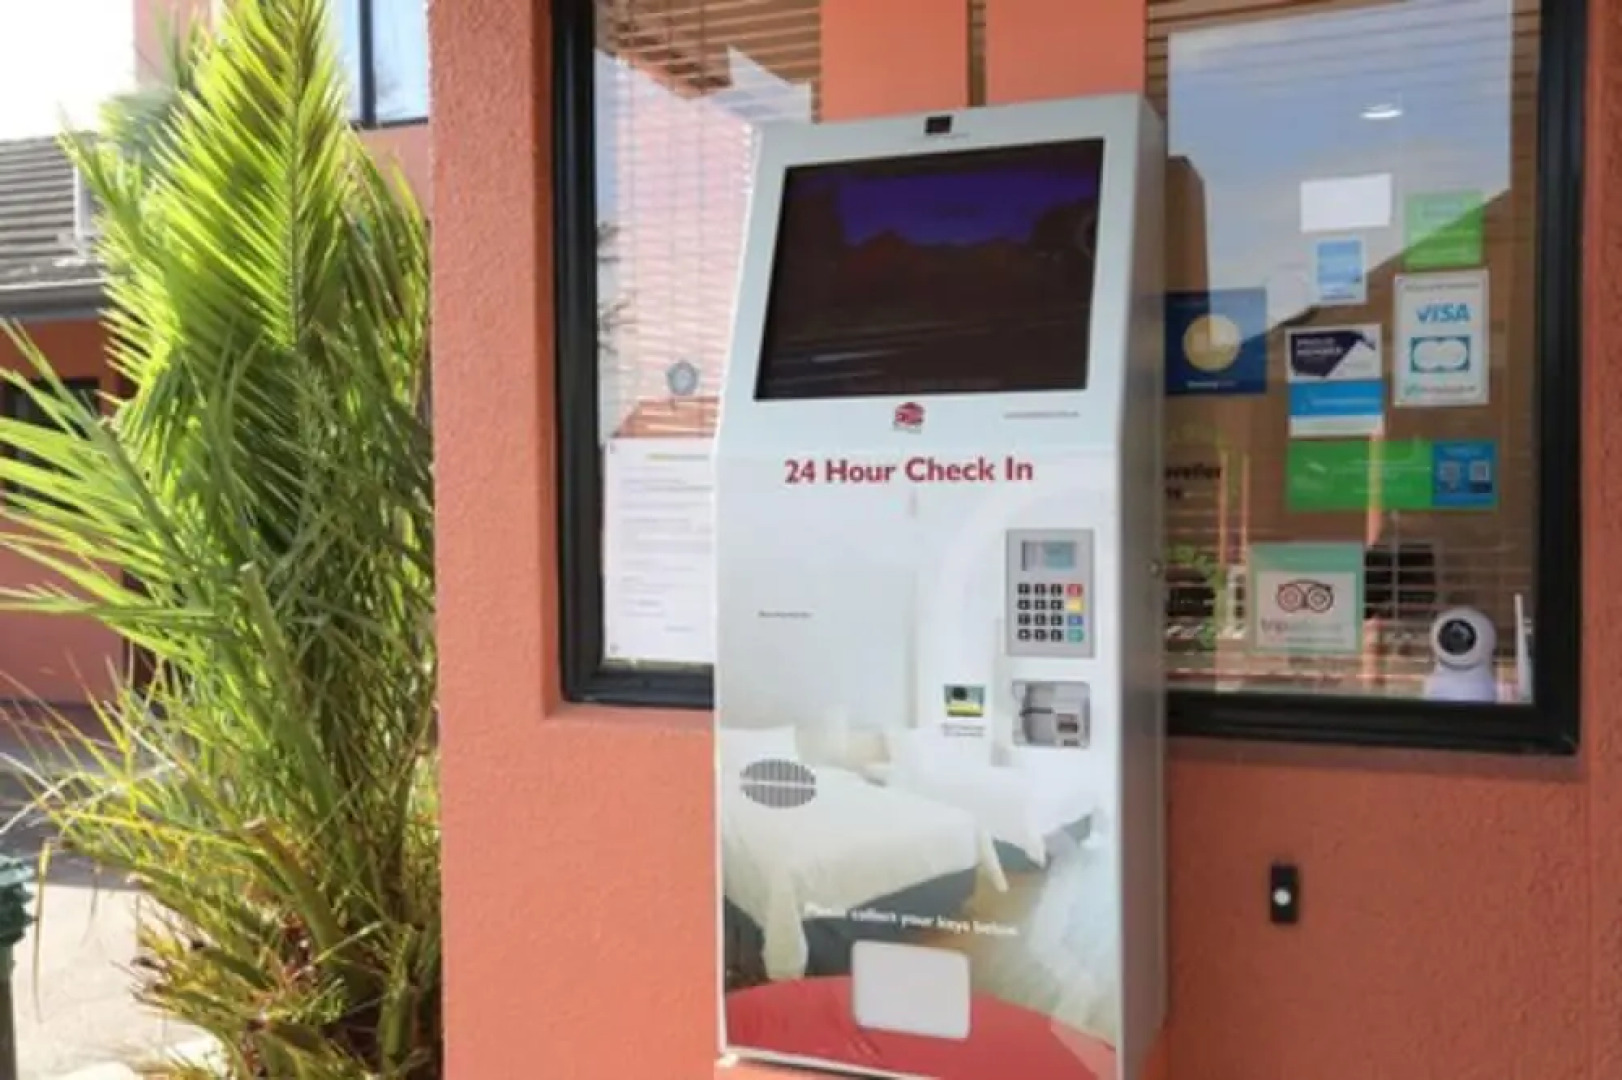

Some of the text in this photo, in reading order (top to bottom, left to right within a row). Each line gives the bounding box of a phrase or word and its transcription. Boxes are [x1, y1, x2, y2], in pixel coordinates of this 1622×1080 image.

[1415, 302, 1471, 324] VISA
[784, 456, 1033, 483] 24 Hour Check In
